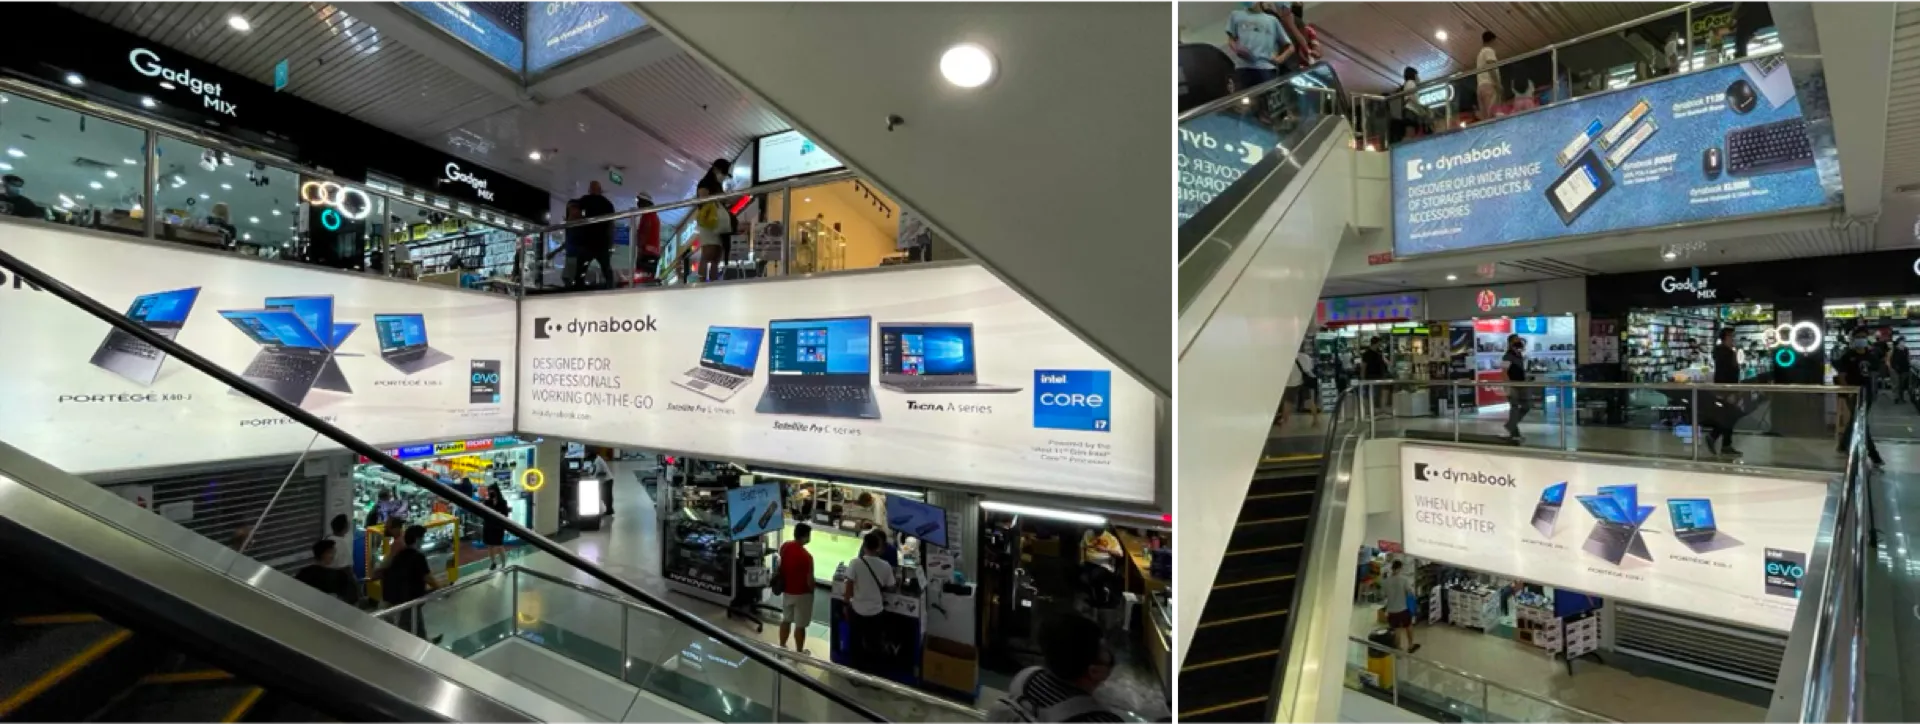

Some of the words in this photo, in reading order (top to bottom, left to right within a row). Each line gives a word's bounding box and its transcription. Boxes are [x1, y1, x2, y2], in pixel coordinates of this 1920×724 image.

[129, 47, 222, 96] Gadget
[203, 94, 238, 118] MIX
[1435, 141, 1512, 170] dynabook
[445, 161, 487, 189] Gadget
[1408, 179, 1451, 198] DISCOVER
[1453, 175, 1475, 190] OUR
[1477, 168, 1503, 184] WIDE
[1504, 161, 1542, 179] RANGE
[477, 187, 495, 202] MIX
[1408, 199, 1421, 211] OF
[1423, 189, 1464, 210] STORAGE
[1465, 181, 1521, 201] PRODUCTS
[1523, 180, 1532, 191] &
[1408, 204, 1470, 224] ACCESSORIES
[1697, 288, 1717, 299] MIX
[567, 315, 656, 337] dynabook
[533, 357, 585, 371] DESIGNED
[588, 357, 611, 371] FOR
[472, 372, 499, 384] evo
[533, 373, 621, 389] PROFESSIONALS
[1040, 374, 1067, 384] intel
[532, 389, 582, 404] WORKING
[584, 392, 654, 409] ON-THE-GO
[947, 402, 955, 411] A
[958, 404, 993, 414] series
[772, 420, 808, 432] Satellite
[809, 423, 823, 434] Pro
[1094, 419, 1107, 429] i7
[435, 443, 464, 452] Nikon
[1442, 467, 1517, 488] dynabook
[1415, 495, 1448, 511] WHEN
[1451, 500, 1484, 515] LIGHT
[1416, 510, 1444, 527] GETS
[1446, 515, 1495, 534] LIGHTER
[1767, 562, 1804, 578] evo
